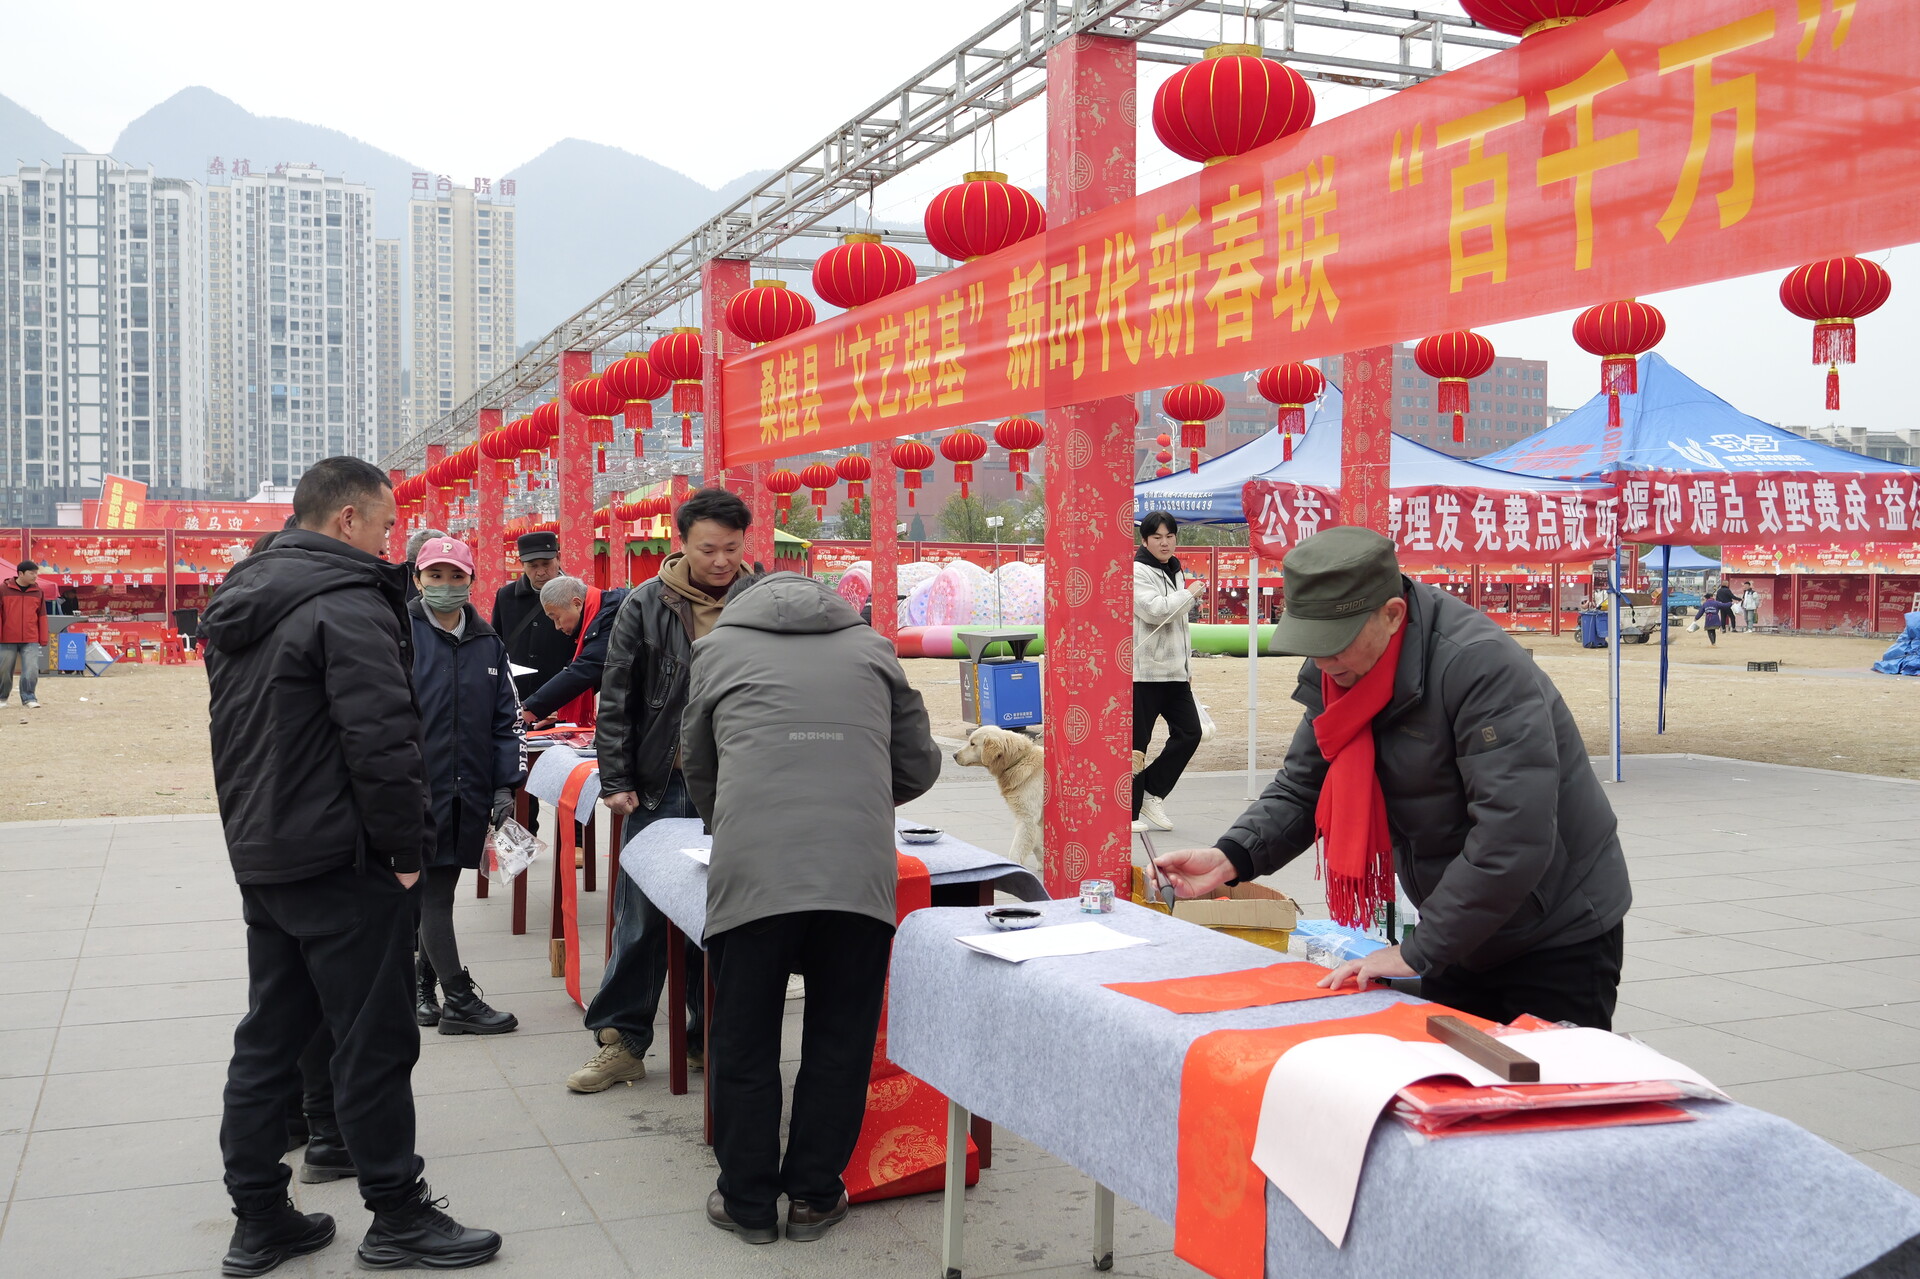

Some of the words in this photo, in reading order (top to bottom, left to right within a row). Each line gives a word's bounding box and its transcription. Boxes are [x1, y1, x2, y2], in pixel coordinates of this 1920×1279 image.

[411, 172, 453, 192] 云谷
[760, 344, 823, 445] 桑植县
[1006, 155, 1341, 390] 新时代新春联
[442, 543, 453, 553] P
[62, 574, 153, 585] 长沙臭豆腐
[1335, 598, 1367, 613] SPIRIT
[1062, 785, 1087, 797] 2026
